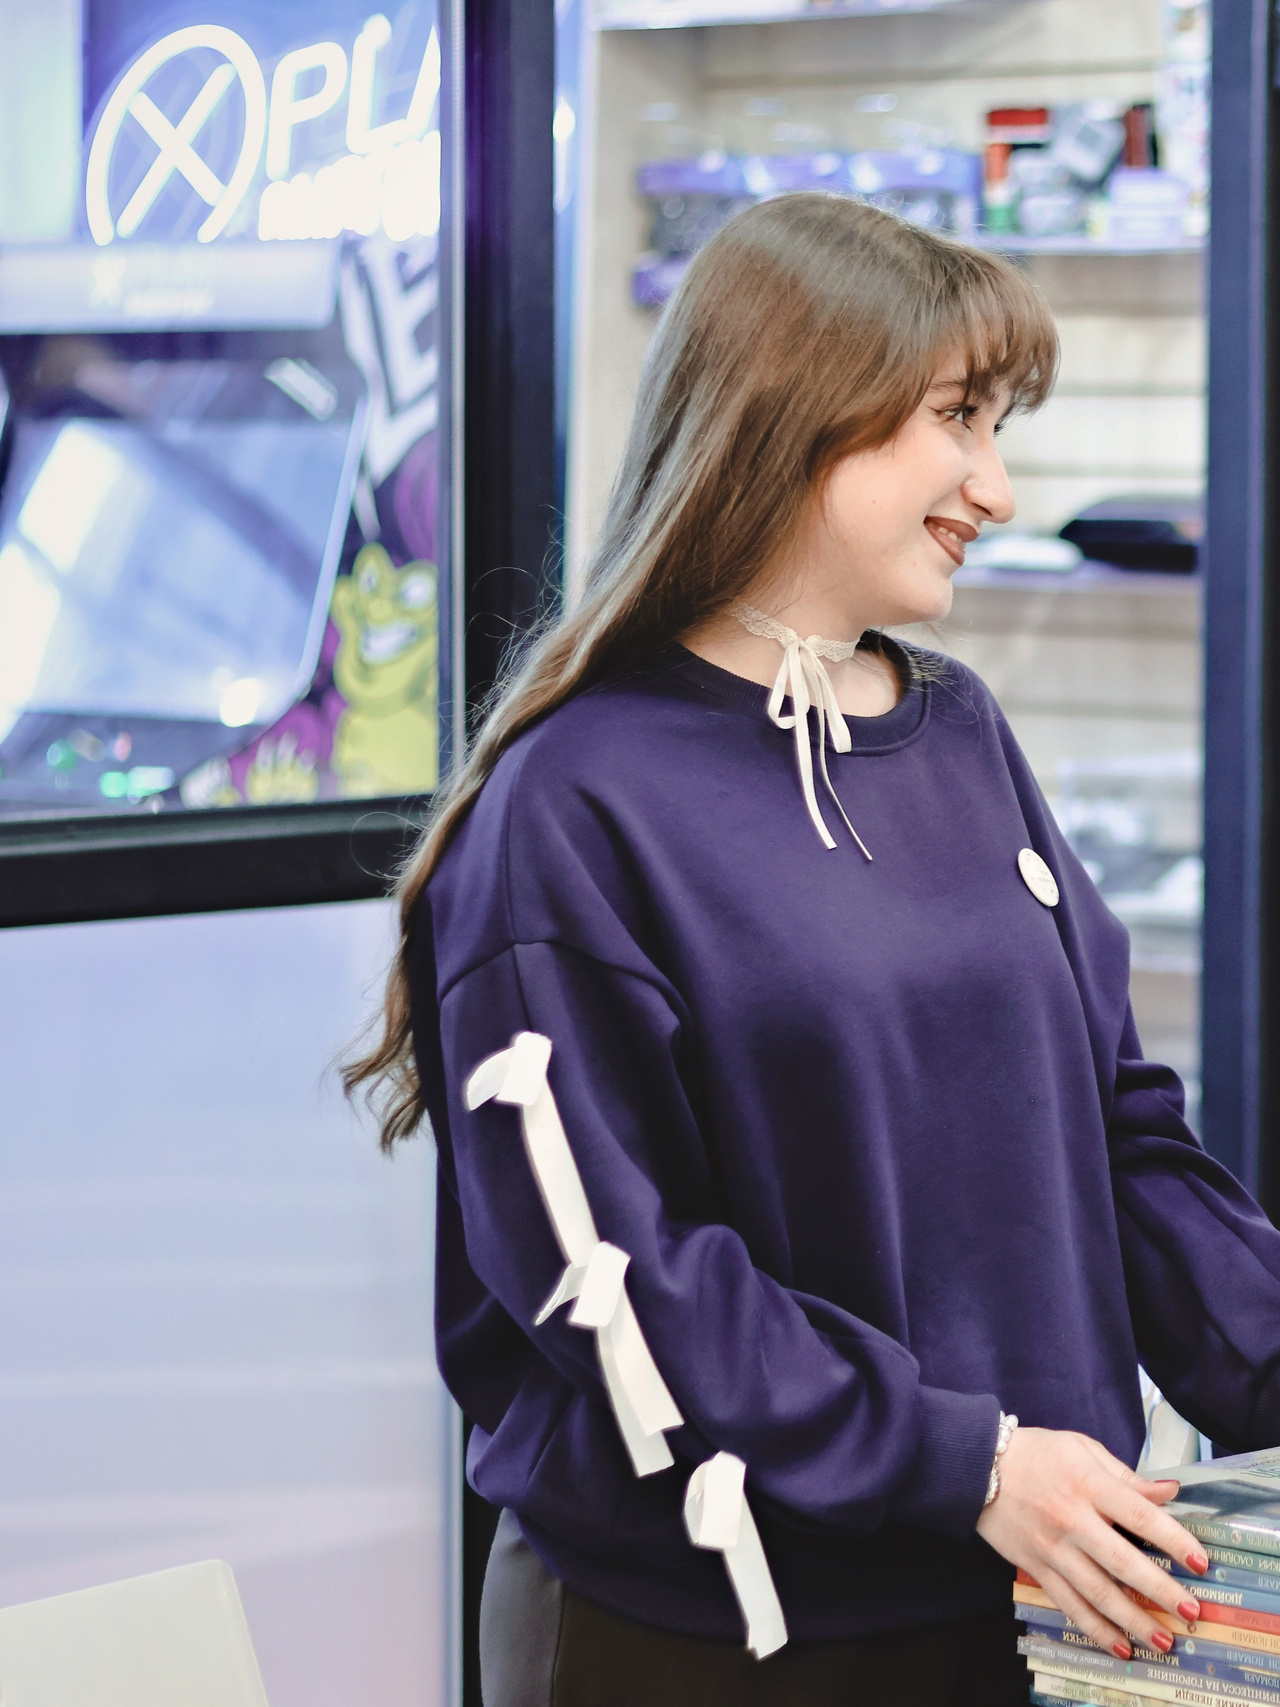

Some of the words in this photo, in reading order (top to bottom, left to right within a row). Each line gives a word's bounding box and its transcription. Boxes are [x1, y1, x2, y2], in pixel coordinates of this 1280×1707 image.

[1246, 1534, 1278, 1551] ЧЕЛОВЕК
[1183, 1584, 1243, 1605] ДЮЙМОВО
[1062, 1630, 1101, 1649] ОВЕЧКИ
[1231, 1631, 1266, 1647] ЛОМАЕВ
[1030, 1645, 1056, 1658] Ломаев
[1057, 1651, 1079, 1663] Антон
[1133, 1647, 1180, 1667] МАЛЕНЬК
[1226, 1651, 1264, 1667] ЛОМАЕВ
[1080, 1655, 1114, 1669] художник
[1068, 1665, 1091, 1678] Антон
[1090, 1670, 1127, 1686] художник
[1147, 1668, 1203, 1689] ГОРОШИНЕ
[1205, 1681, 1220, 1691] НА
[1244, 1672, 1280, 1689] ЛОМАЕВ
[1174, 1689, 1213, 1706] ЛЕБЕДИ
